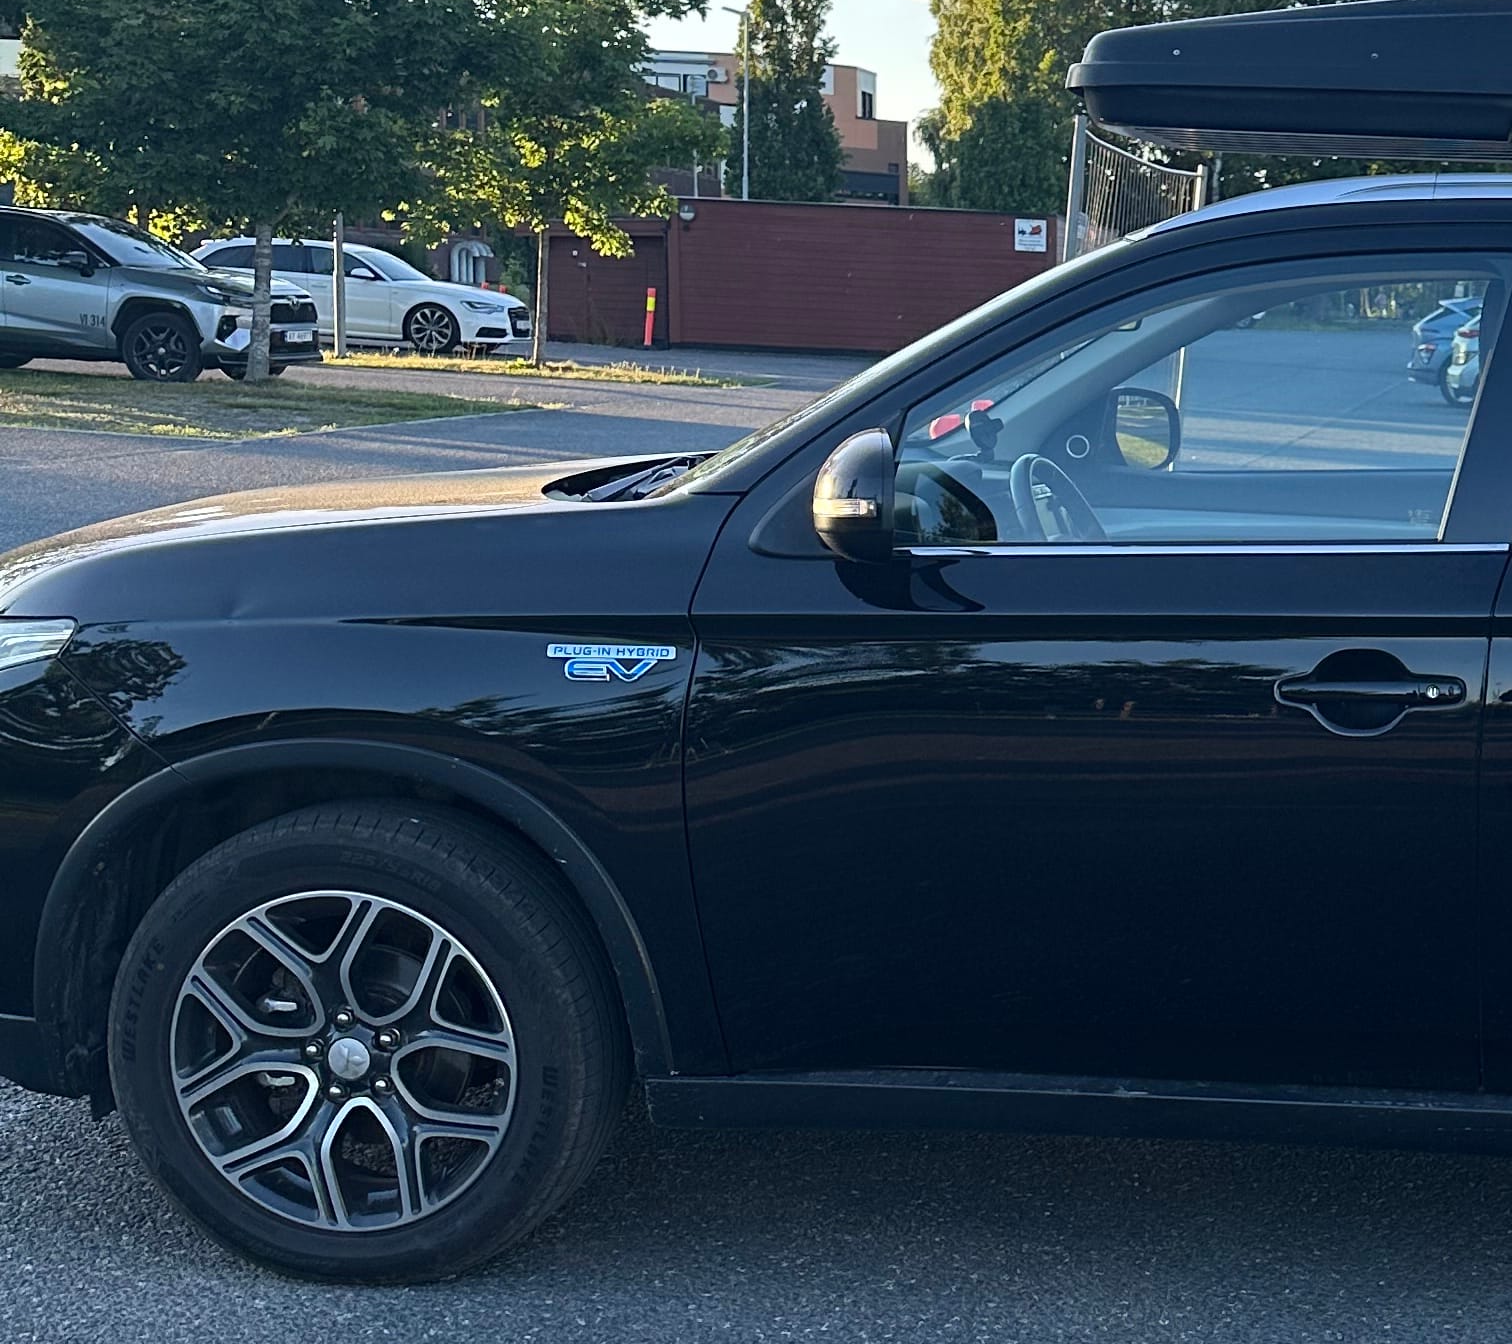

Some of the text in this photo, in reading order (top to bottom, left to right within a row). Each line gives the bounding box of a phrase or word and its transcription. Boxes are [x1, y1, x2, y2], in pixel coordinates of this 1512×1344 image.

[90, 314, 105, 327] 314
[553, 646, 670, 658] PLUG-IN HYBRID
[564, 658, 658, 682] EV
[121, 937, 165, 1062] WESTLAKE
[511, 1064, 559, 1186] WESTLAKE
